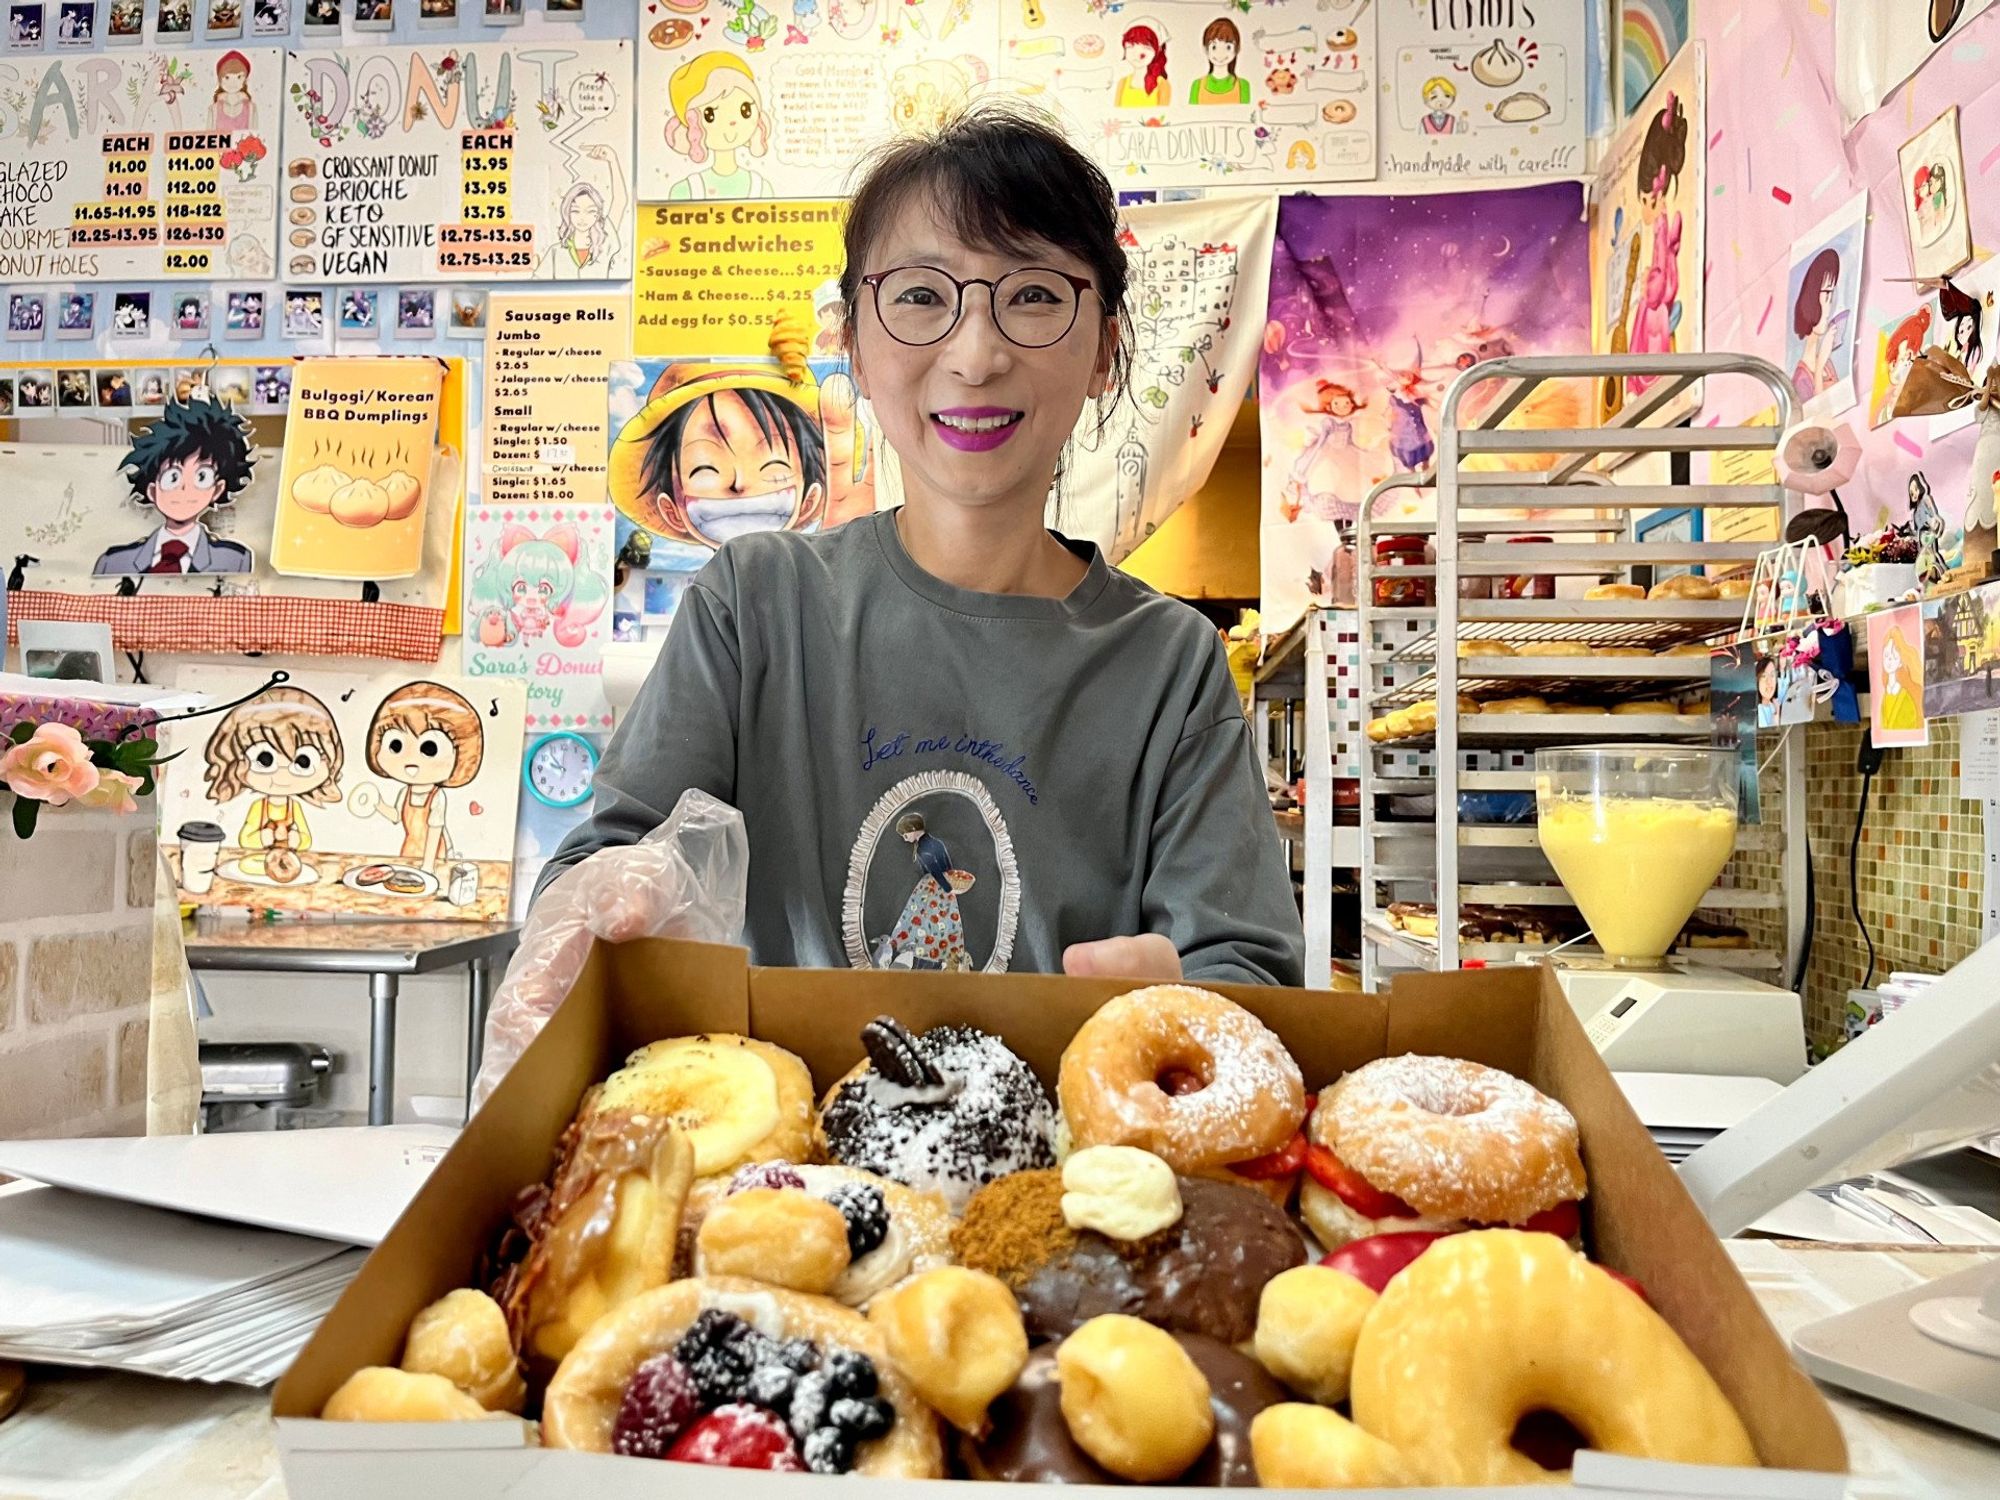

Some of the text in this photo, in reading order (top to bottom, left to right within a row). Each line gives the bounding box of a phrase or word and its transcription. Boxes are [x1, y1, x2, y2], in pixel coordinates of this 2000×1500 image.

[304, 49, 578, 136] DONUT
[103, 135, 231, 151] EACH DOZEN
[463, 135, 513, 149] EACH
[1118, 127, 1245, 160] SARA DONUTS
[108, 157, 215, 174] $1.00 $11.00
[322, 154, 438, 180] CROISSANT DONUT
[466, 158, 508, 171] $3.95
[1479, 154, 1508, 174] with
[0, 182, 53, 204] HOCO
[106, 180, 216, 196] $1.10 $12.00
[324, 179, 408, 201] BRIOCHE
[465, 182, 507, 195] $3.95
[0, 204, 38, 228] AKE
[75, 203, 222, 220] $1.65-$1.95 $18-$22
[326, 204, 384, 224] KETO
[464, 206, 505, 219] $3.75
[656, 205, 839, 225] Sara's Croissant
[0, 227, 70, 250] OURMET
[72, 226, 224, 242] $2.25-$3.95 $26-$30
[321, 224, 435, 248] GF SENSITIVE
[441, 229, 532, 243] $2.75-$3.50
[679, 235, 814, 253] Sandwiches
[0, 253, 99, 277] ONUT HOLES
[167, 254, 208, 268] $2.00
[323, 251, 388, 274] VEGAN
[440, 253, 531, 266] $2.75-$3.25
[712, 266, 722, 276] &
[682, 291, 693, 300] &
[505, 309, 614, 324] Sausage Rolls
[638, 313, 774, 328] Add egg for $0.55
[496, 330, 541, 341] Jumbo
[502, 348, 545, 358] Regular
[496, 361, 529, 370] $2.65
[301, 389, 434, 404] Bulgogi/Korean
[495, 388, 528, 397] $2.65
[304, 409, 429, 424] BBQ Dumplings
[494, 406, 532, 416] Small
[500, 424, 543, 434] Regular
[493, 437, 530, 447] Single:
[493, 451, 530, 460] Dozen:
[493, 477, 529, 487] Single:
[493, 491, 529, 499] Dozen:
[468, 652, 528, 677] Sara's
[527, 682, 563, 708] tory
[861, 728, 910, 770] Let
[915, 735, 950, 754] me
